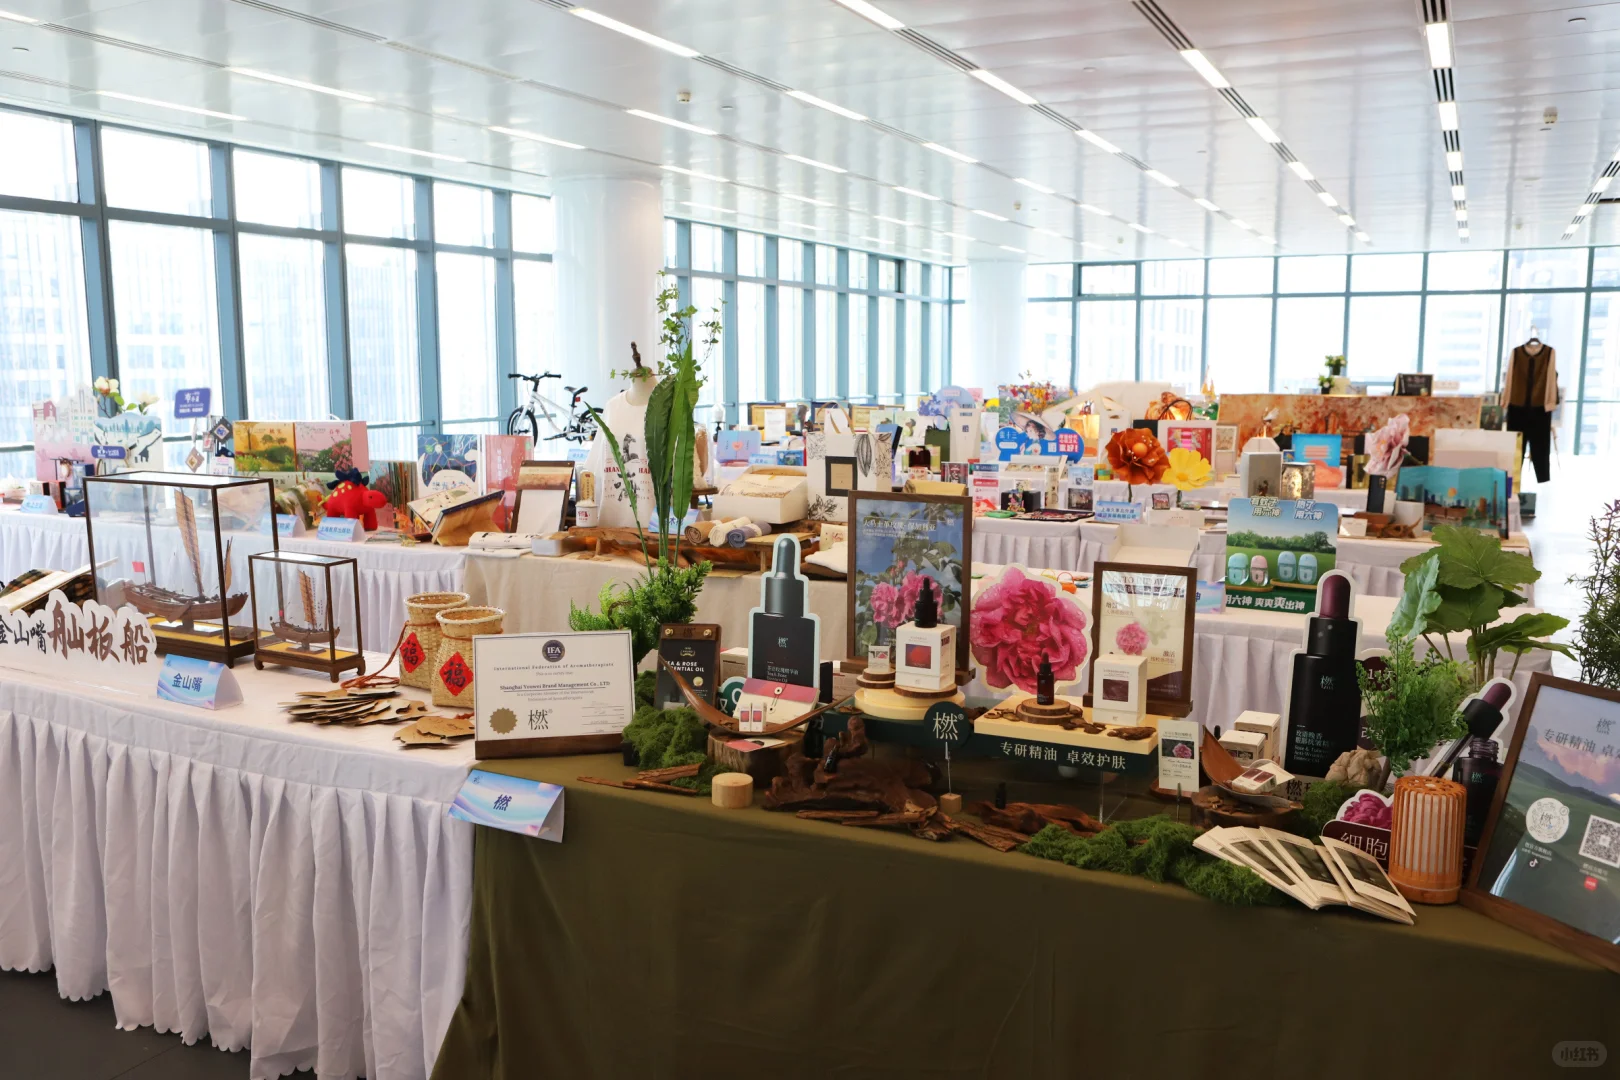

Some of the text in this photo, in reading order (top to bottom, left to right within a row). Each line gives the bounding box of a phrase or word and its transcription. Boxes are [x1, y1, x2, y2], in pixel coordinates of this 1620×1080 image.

[1251, 497, 1314, 510] 有蚊子 热了
[1253, 507, 1323, 520] 用六神 用六神
[1255, 596, 1305, 610] 爽爽爽出神
[403, 640, 418, 666] 福
[547, 646, 562, 654] IFA
[172, 673, 203, 692] 金山嘴
[444, 662, 466, 688] 福
[1544, 728, 1596, 753] 专研精油
[1000, 742, 1126, 770] 专研精油 卓效护肤
